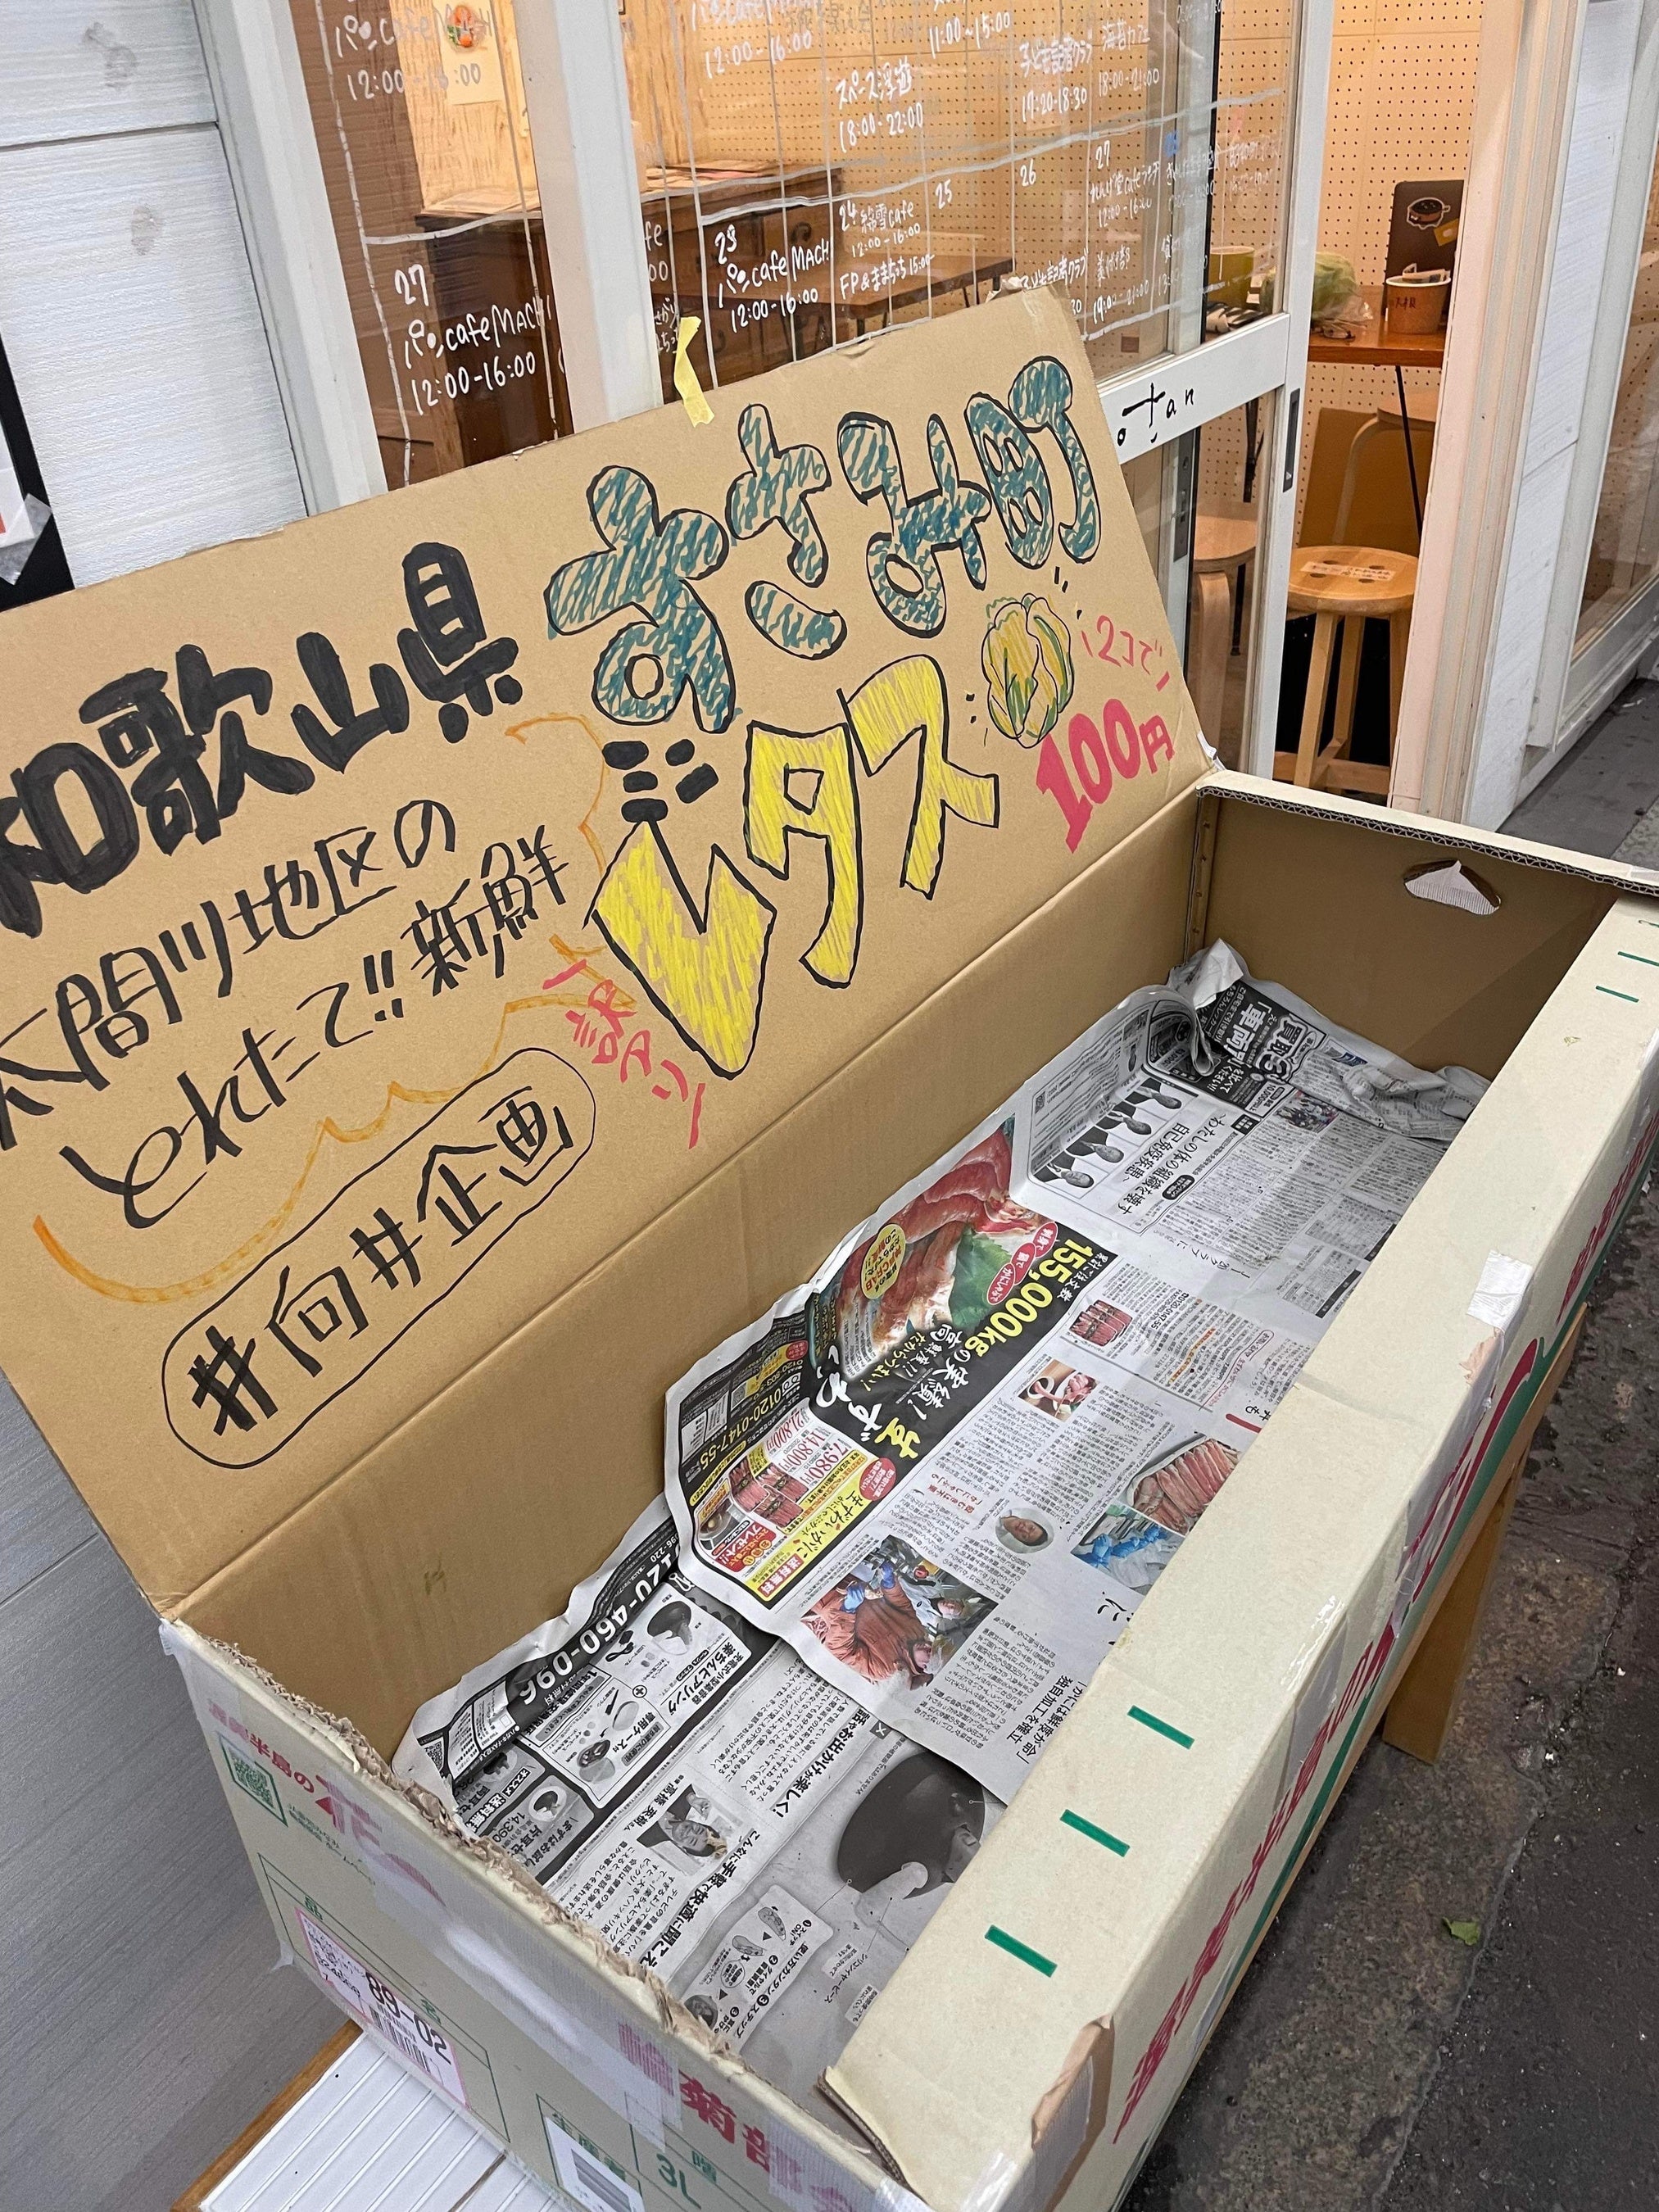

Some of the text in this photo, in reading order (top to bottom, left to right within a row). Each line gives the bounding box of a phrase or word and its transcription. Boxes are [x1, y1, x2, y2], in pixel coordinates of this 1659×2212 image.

[1019, 158, 1037, 187] 26
[1095, 140, 1111, 170] 27
[935, 179, 953, 210] 25
[394, 263, 429, 307] 27
[411, 351, 537, 416] 12:00-16:00
[544, 355, 1101, 733] すさみ町
[0, 542, 524, 938] 和歌山県
[1036, 698, 1176, 854] 100円
[582, 654, 1000, 1081] レタス
[858, 1330, 927, 1392] だからうまい!
[696, 1388, 785, 1471] 0120-0147-55
[718, 1521, 762, 1565] プレゼント!!
[795, 1489, 866, 1560] 生ずわいがに
[759, 1554, 800, 1594] 送料無料
[518, 1543, 678, 1707] 120-460-096
[663, 1641, 737, 1716] 楽ちんヒアリング
[690, 1652, 743, 1706] 充電式小型集音器
[771, 1707, 870, 1819] 話やお出かけが楽しく!
[823, 1952, 868, 2004] シリコンイヤーピース
[365, 1970, 452, 2065] 89-02
